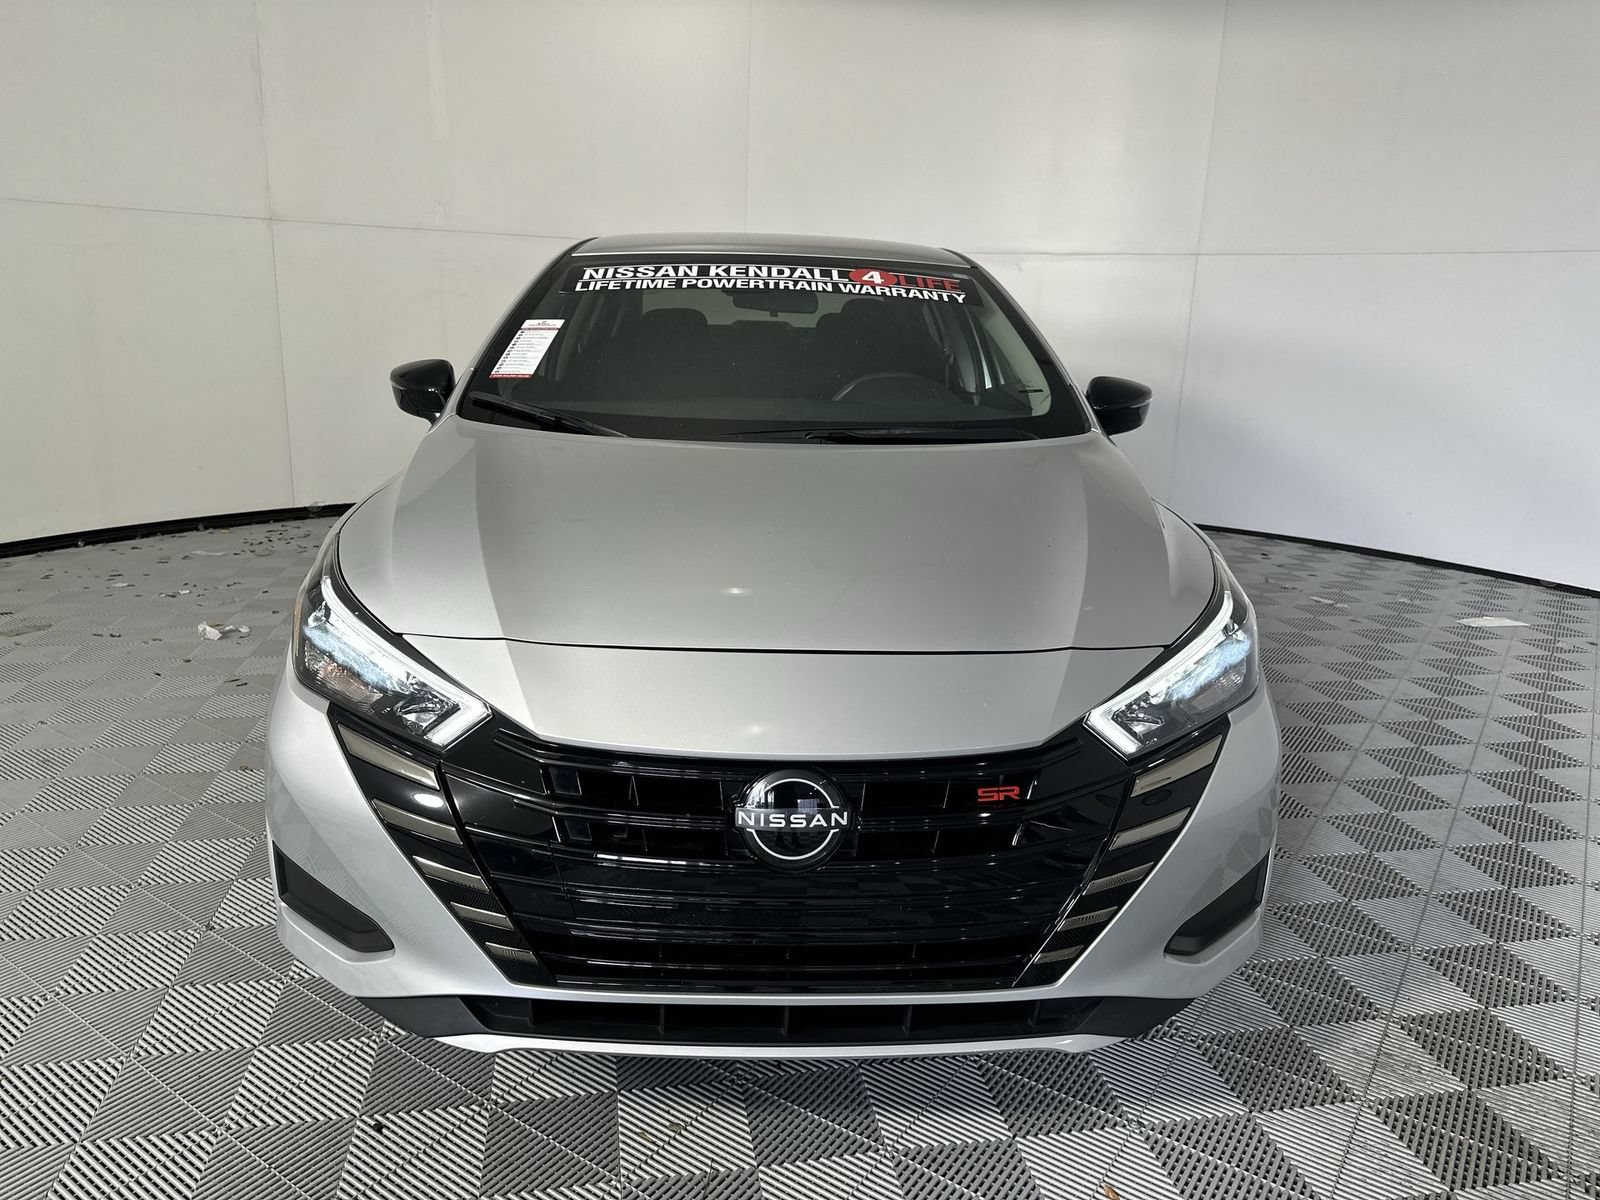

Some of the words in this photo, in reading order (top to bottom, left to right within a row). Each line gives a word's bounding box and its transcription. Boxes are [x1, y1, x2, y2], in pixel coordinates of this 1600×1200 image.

[582, 265, 698, 280] NISSAN
[709, 265, 849, 282] KENDALL
[861, 271, 885, 285] 4
[896, 274, 961, 291] LIFE
[575, 278, 676, 292] LIFETIME
[681, 278, 834, 292] POWERTRAIN
[837, 283, 967, 304] WARRANTY
[977, 785, 1020, 802] SR
[738, 811, 848, 828] NISSAN
